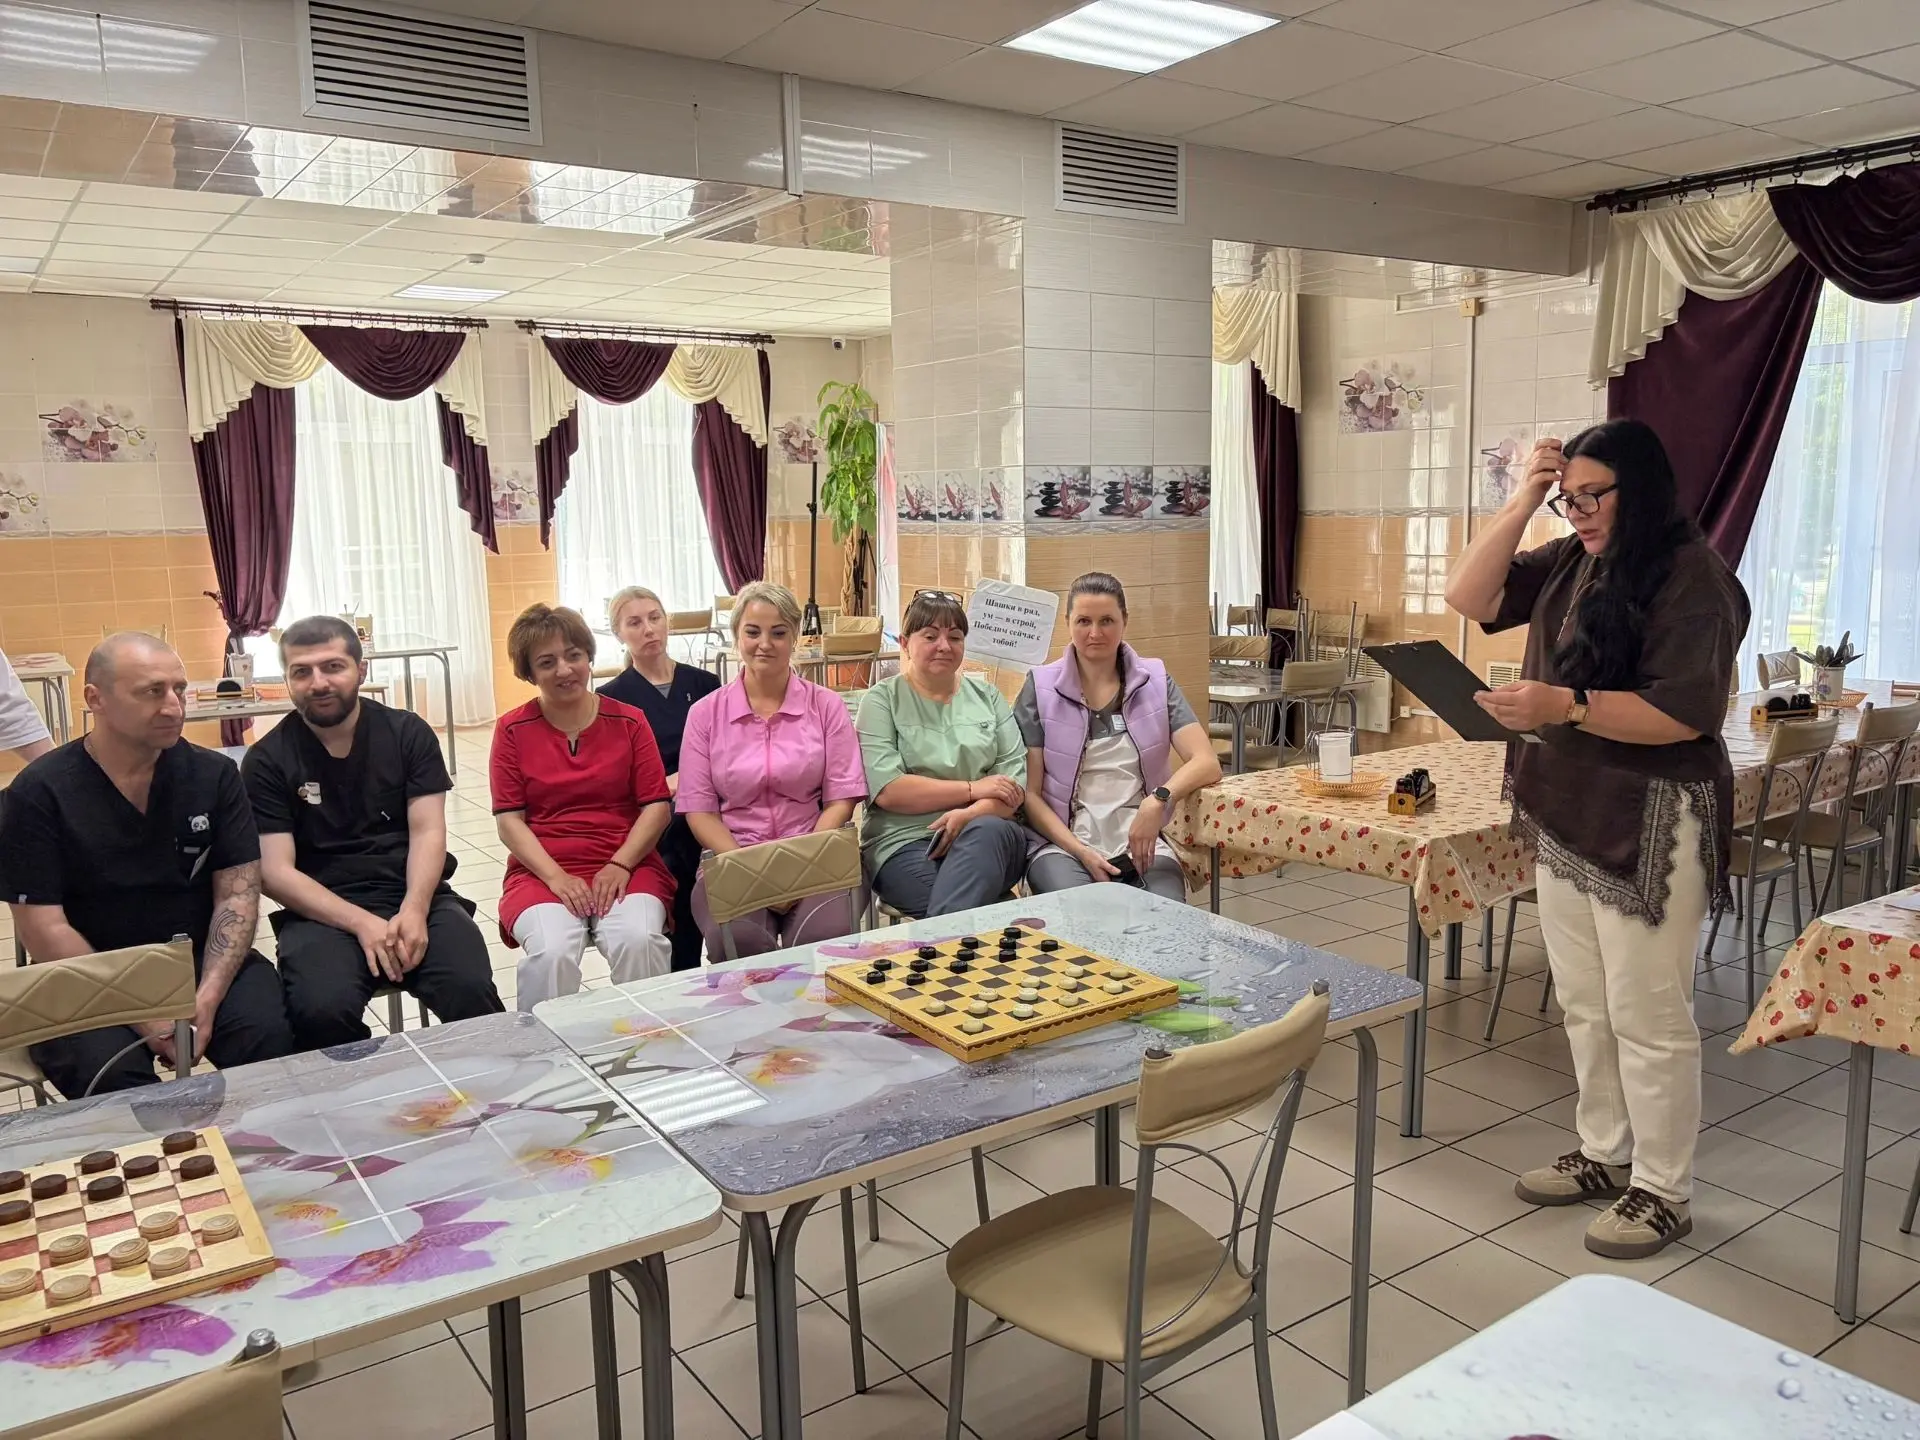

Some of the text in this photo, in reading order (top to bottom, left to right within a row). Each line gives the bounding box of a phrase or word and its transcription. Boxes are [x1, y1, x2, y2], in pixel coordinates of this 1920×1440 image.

[985, 598, 1016, 611] Шашки
[982, 612, 994, 620] ум
[1012, 618, 1037, 629] строй,
[974, 620, 1008, 634] Победим
[1009, 629, 1036, 640] сейчас
[992, 637, 1018, 648] тобой!
